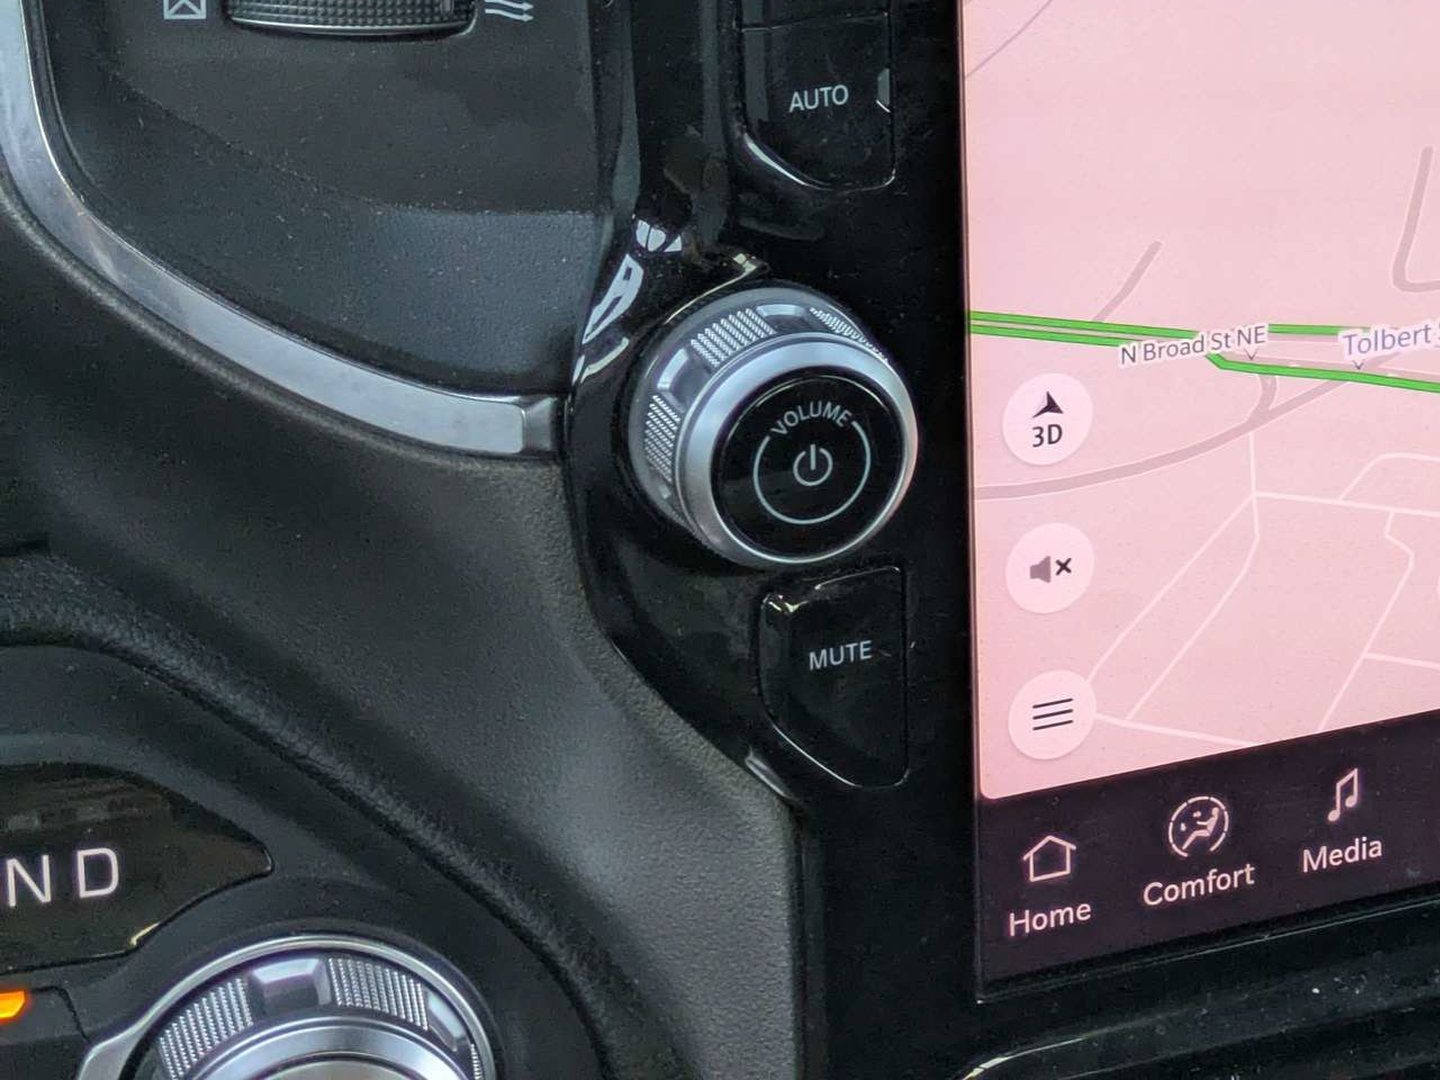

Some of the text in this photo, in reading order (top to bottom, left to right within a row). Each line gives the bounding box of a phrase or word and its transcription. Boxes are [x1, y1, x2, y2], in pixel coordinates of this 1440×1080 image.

[789, 84, 850, 114] AUTO
[1120, 325, 1268, 366] N Broad St NE
[1343, 323, 1433, 357] Tolbert
[769, 400, 854, 438] VOLUME
[1031, 423, 1064, 449] 3D
[808, 640, 873, 671] MUTE
[1302, 835, 1384, 874] Media
[6, 847, 121, 908] N D
[1142, 861, 1257, 907] Comfort
[1008, 900, 1093, 938] Home
